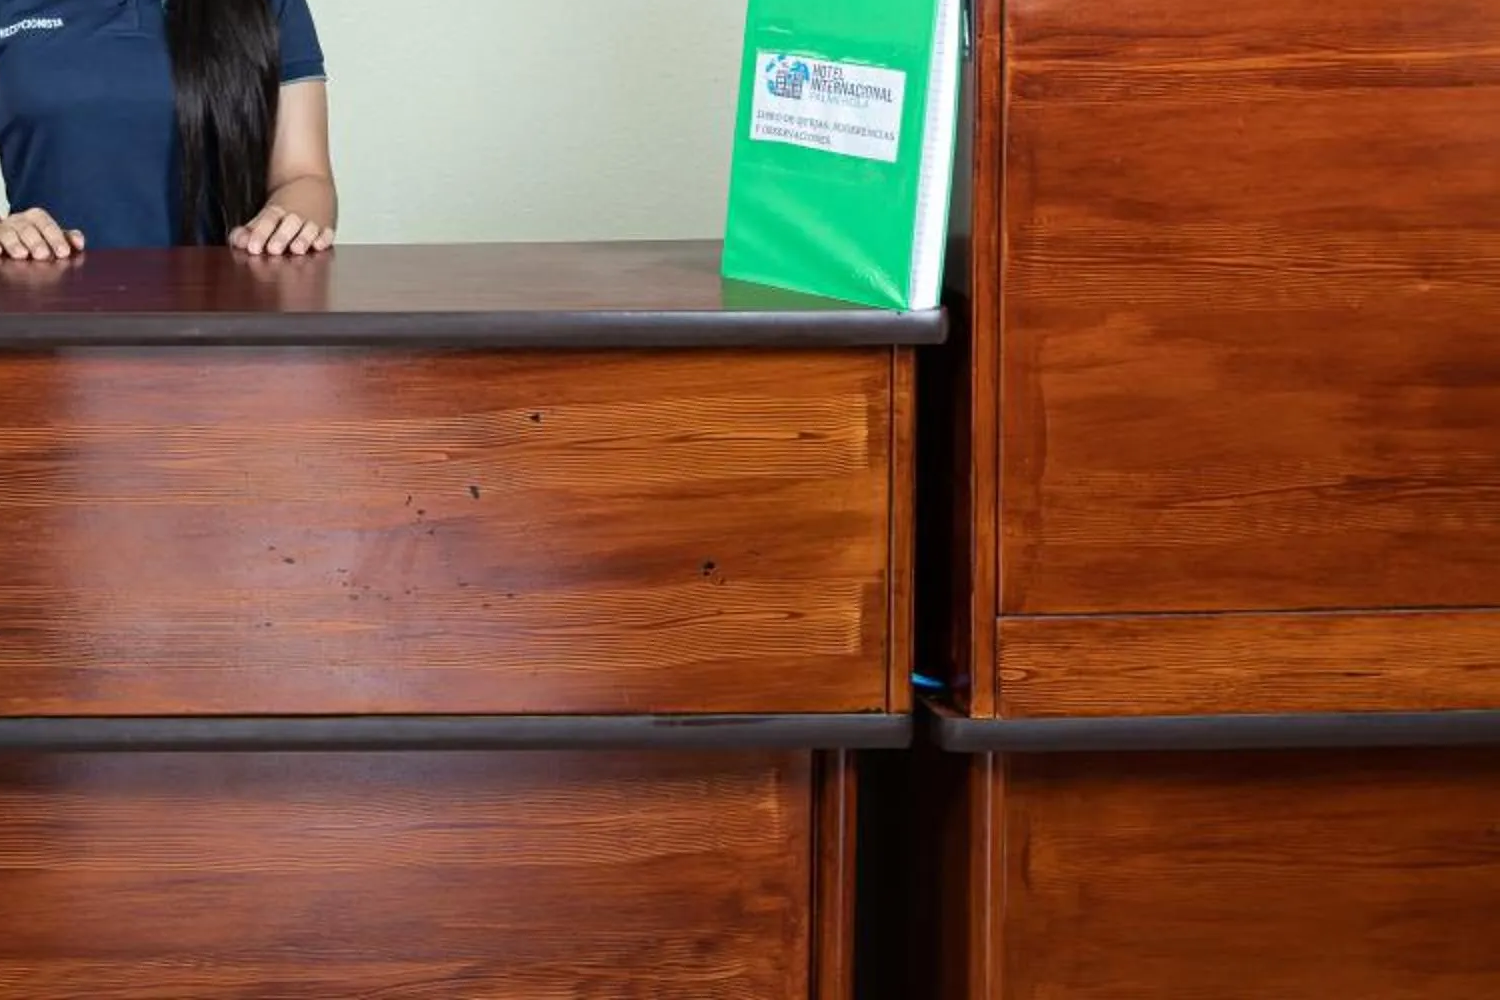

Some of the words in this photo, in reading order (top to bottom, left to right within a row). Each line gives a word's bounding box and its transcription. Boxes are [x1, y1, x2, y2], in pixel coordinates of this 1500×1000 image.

[0, 18, 64, 39] RECEPCIONISTA
[812, 63, 844, 79] HOTEL
[810, 77, 893, 103] INTERNACIONAL
